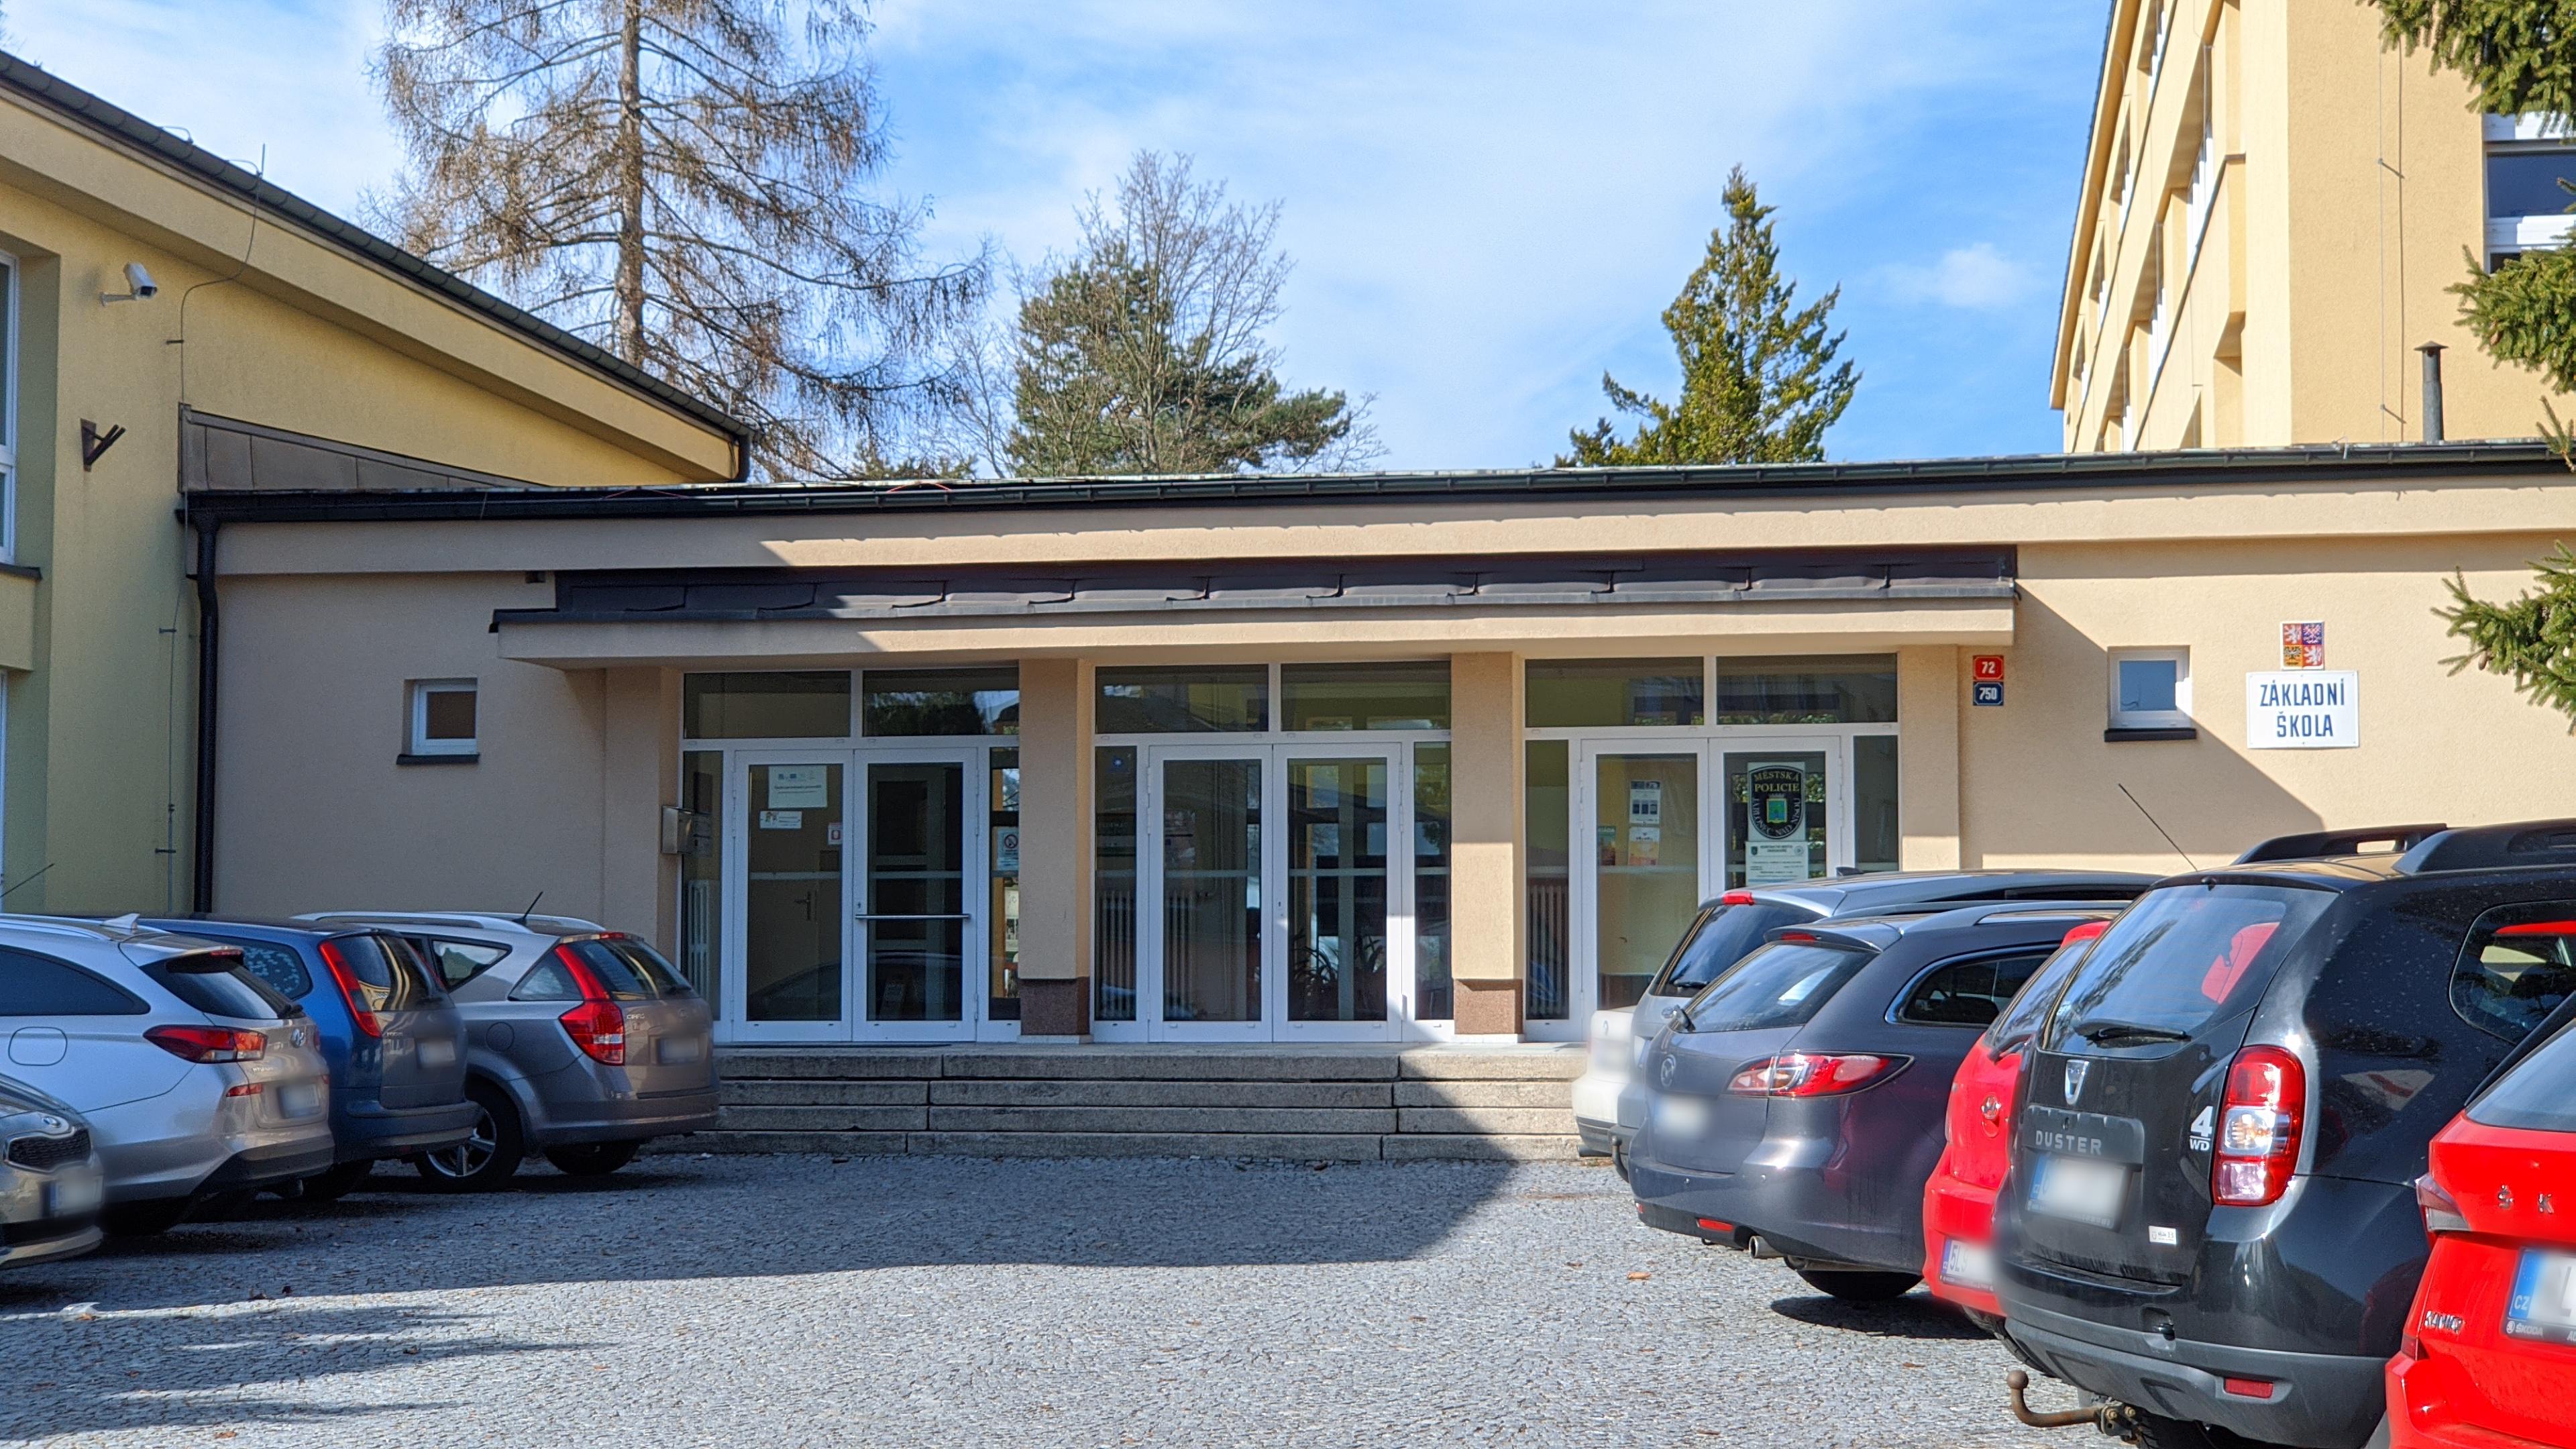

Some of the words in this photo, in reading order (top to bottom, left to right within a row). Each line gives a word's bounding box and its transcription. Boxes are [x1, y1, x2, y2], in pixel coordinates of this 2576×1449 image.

[1982, 661, 1996, 674] 72
[1979, 687, 1997, 700] 750
[2259, 678, 2345, 706] ZÁKLADNÍ
[2276, 711, 2333, 737] ŠKOLA
[1754, 784, 1799, 792] POLICIE
[2190, 1106, 2214, 1137] 4
[2035, 1130, 2102, 1155] DUSTER
[2189, 1138, 2210, 1151] WD
[2514, 1294, 2530, 1311] CZ
[2515, 1322, 2544, 1338] ŠKODA
